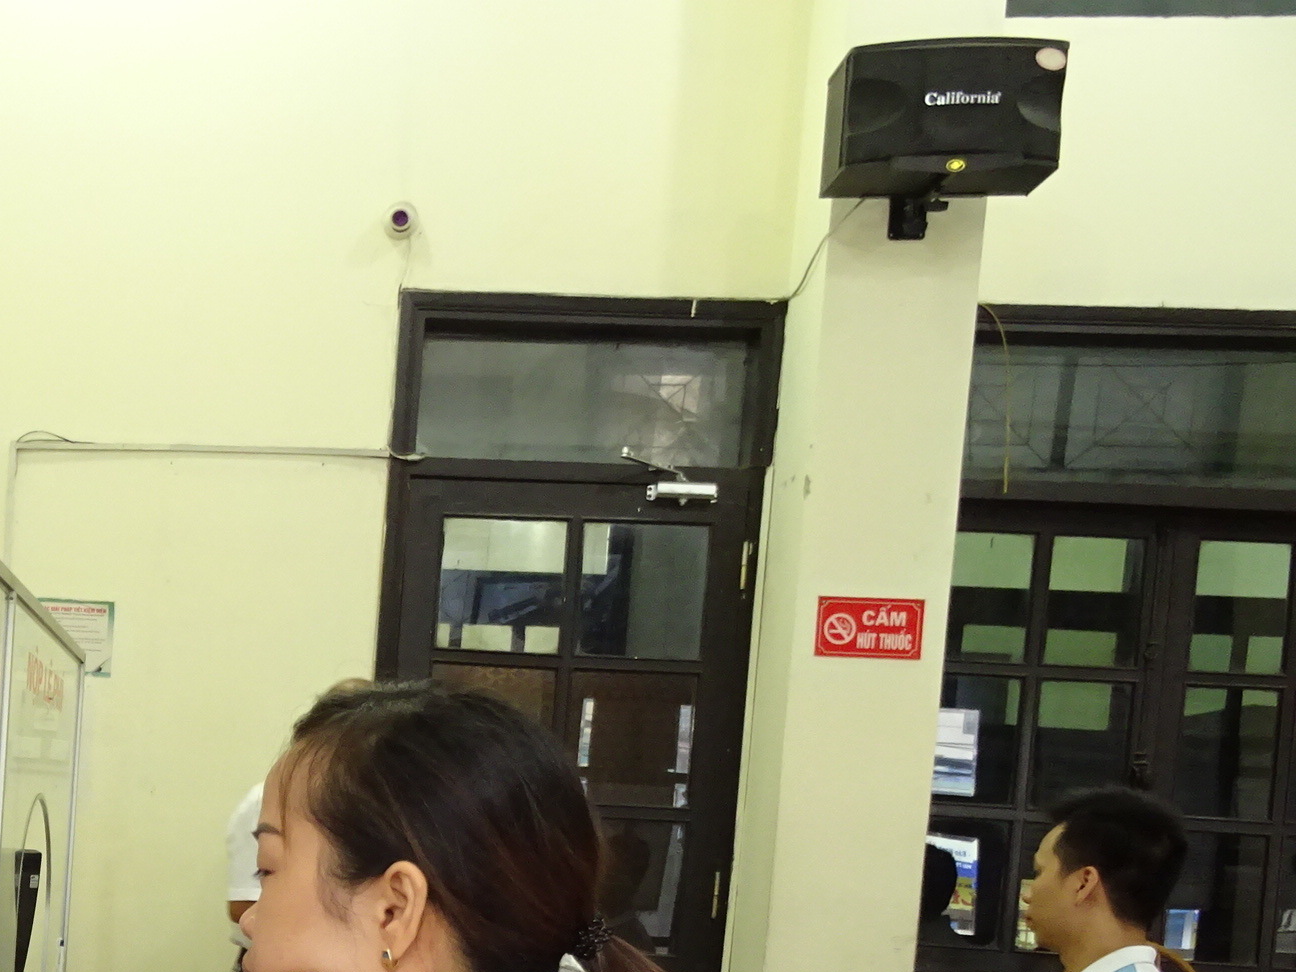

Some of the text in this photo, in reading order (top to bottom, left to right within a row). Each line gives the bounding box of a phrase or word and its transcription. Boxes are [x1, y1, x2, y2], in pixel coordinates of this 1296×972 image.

[924, 91, 1000, 106] California
[862, 604, 907, 627] CẤM
[856, 628, 912, 651] HÚT THUỐC
